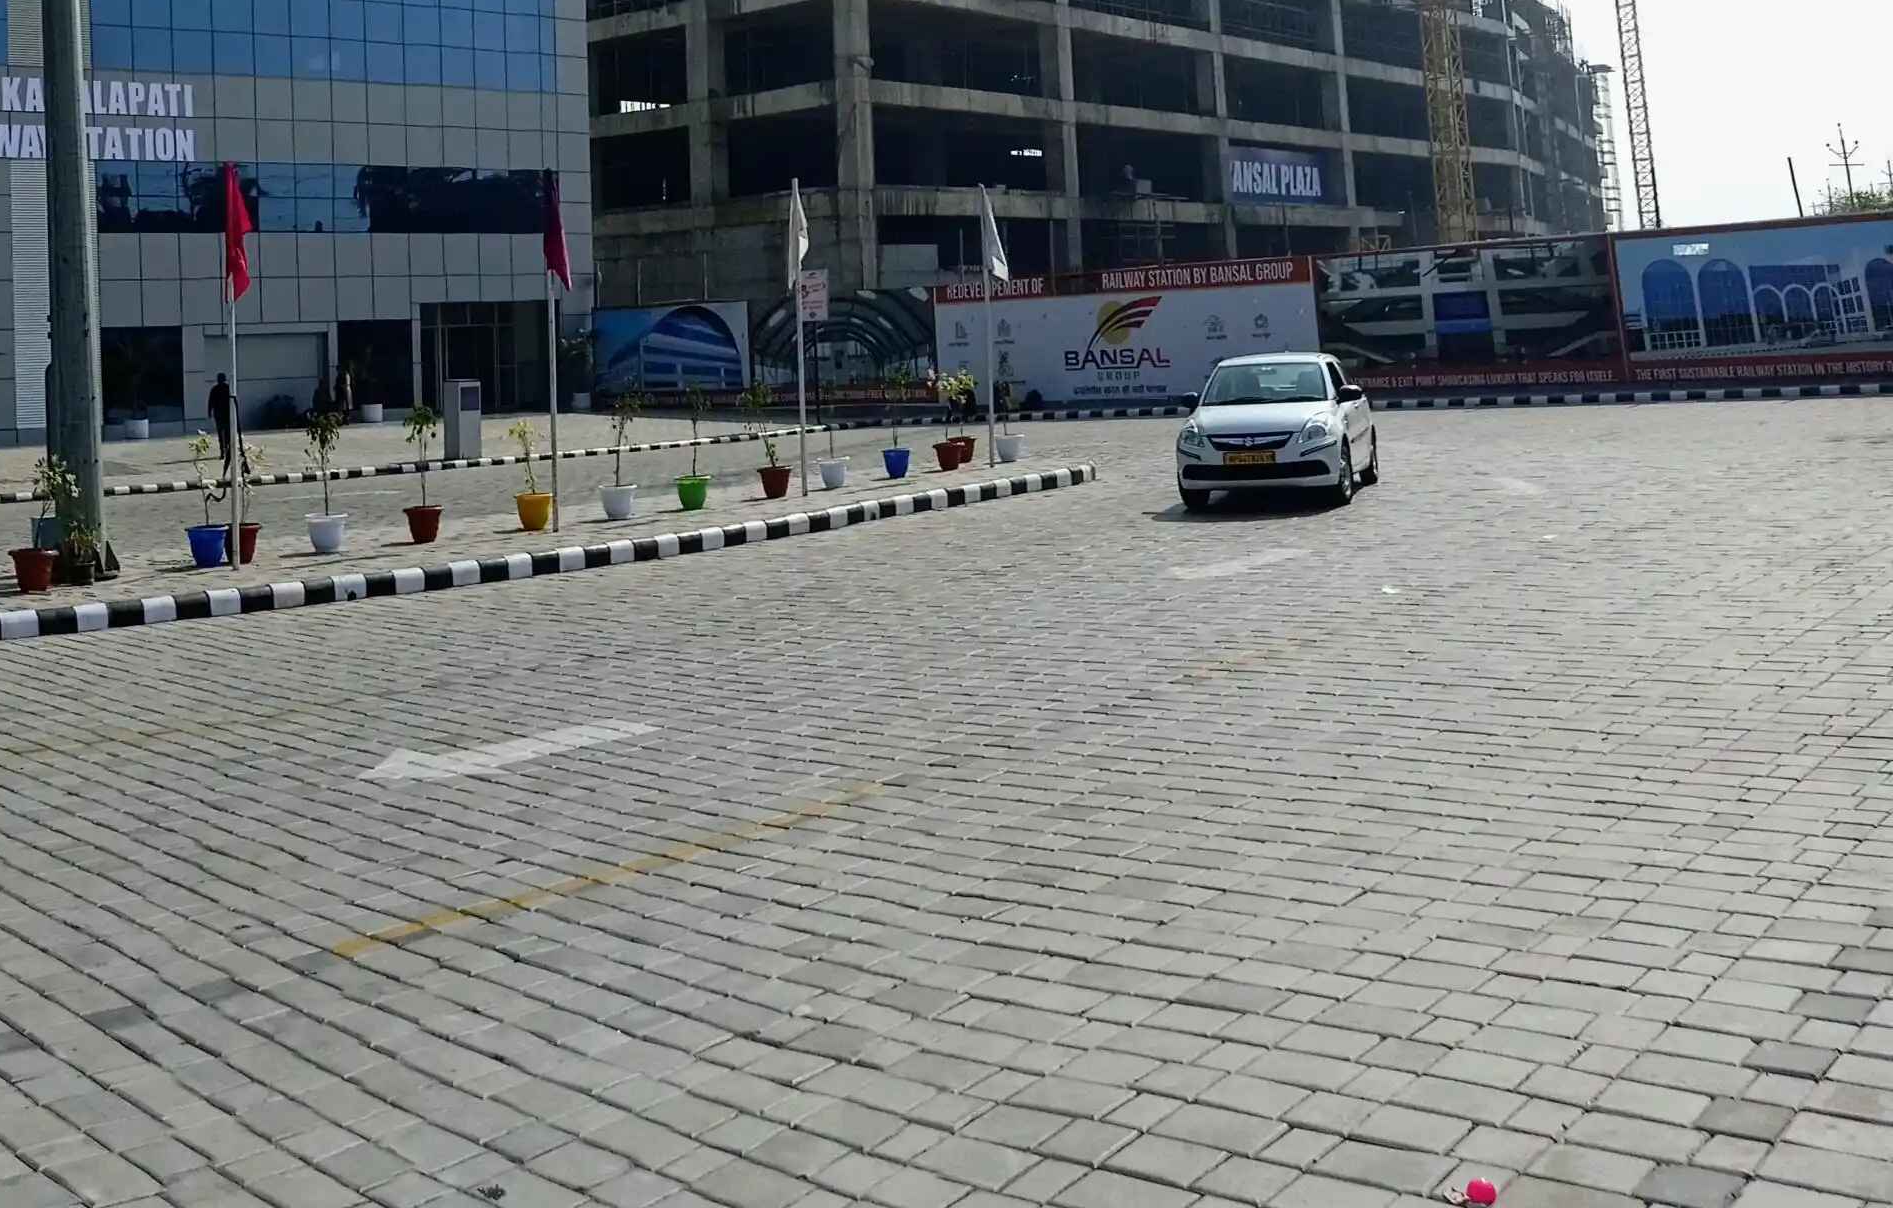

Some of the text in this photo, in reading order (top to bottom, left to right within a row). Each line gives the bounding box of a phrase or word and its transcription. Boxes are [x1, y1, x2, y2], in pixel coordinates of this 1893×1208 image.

[2, 77, 194, 117] KALAPATI
[84, 126, 196, 161] TATION
[1230, 161, 1321, 196] ANSAL PLAZA
[947, 261, 1294, 299] REDEVELPEMENT OF RAILWAY STATION BY BANSAL GROUP
[1065, 347, 1171, 370] BANSAL
[1097, 371, 1140, 380] GROUP
[1635, 369, 1652, 380] THE
[1737, 364, 1775, 377] RAILWAY
[1776, 362, 1813, 376] STATION
[1827, 361, 1845, 374] THE
